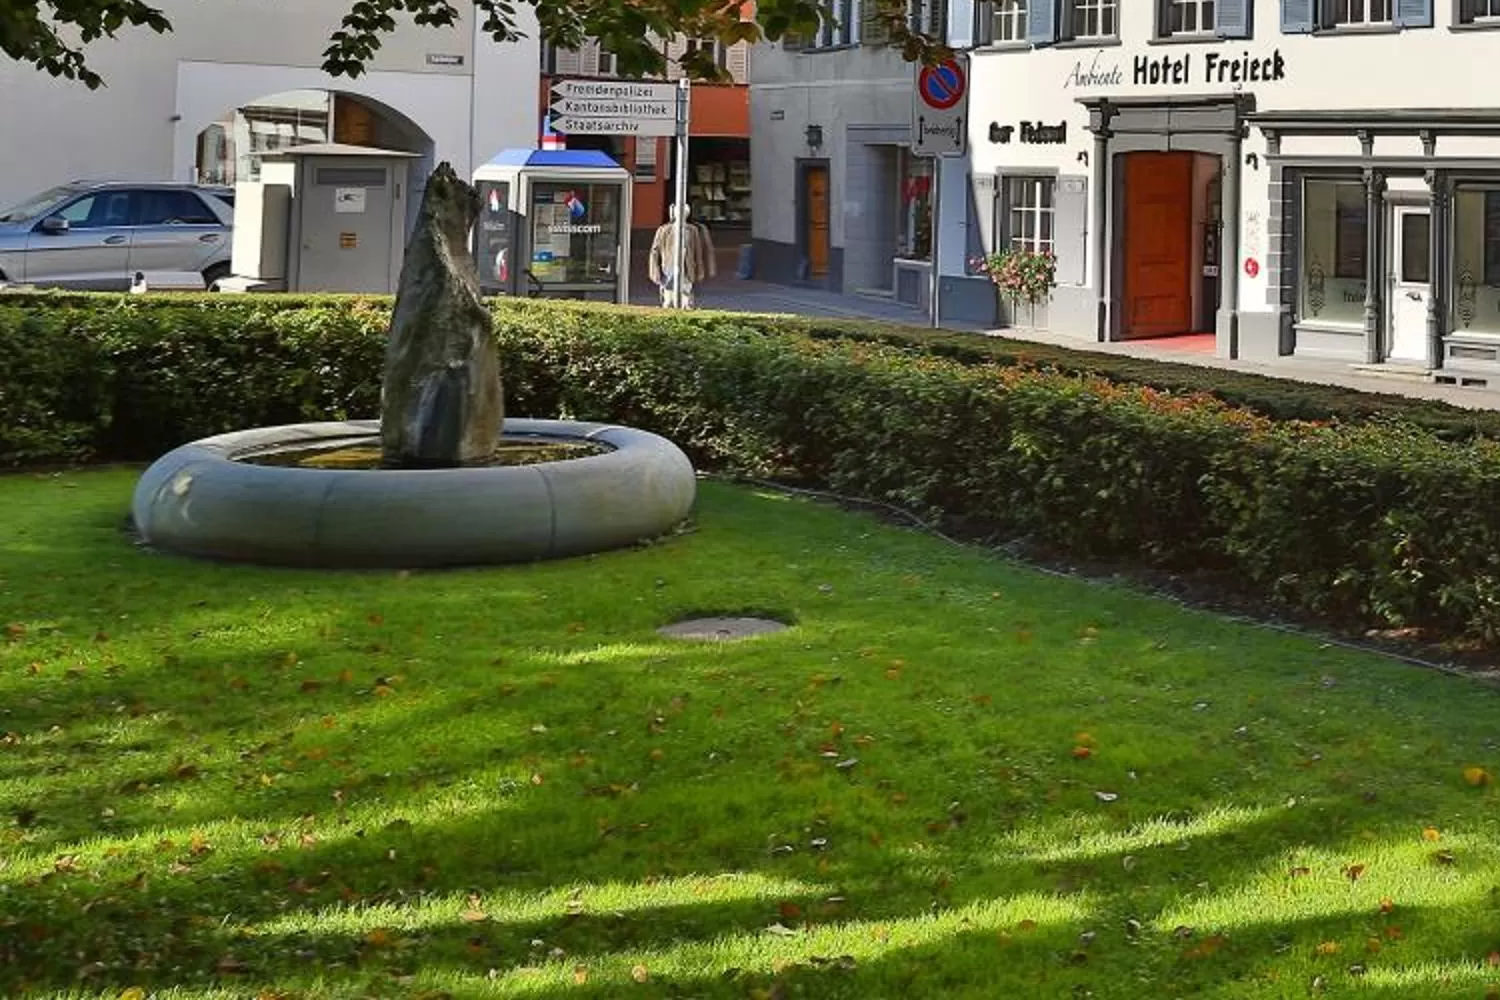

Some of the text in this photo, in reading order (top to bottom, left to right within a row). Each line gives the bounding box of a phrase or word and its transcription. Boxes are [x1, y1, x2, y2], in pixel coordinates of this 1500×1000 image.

[1064, 49, 1285, 88] Ambiente Hotel Freieck
[566, 83, 654, 98] Fremdenpolizei
[565, 101, 668, 115] Kantonsbibliothek
[565, 119, 641, 131] Staatsarchiv
[548, 220, 602, 234] swisscom
